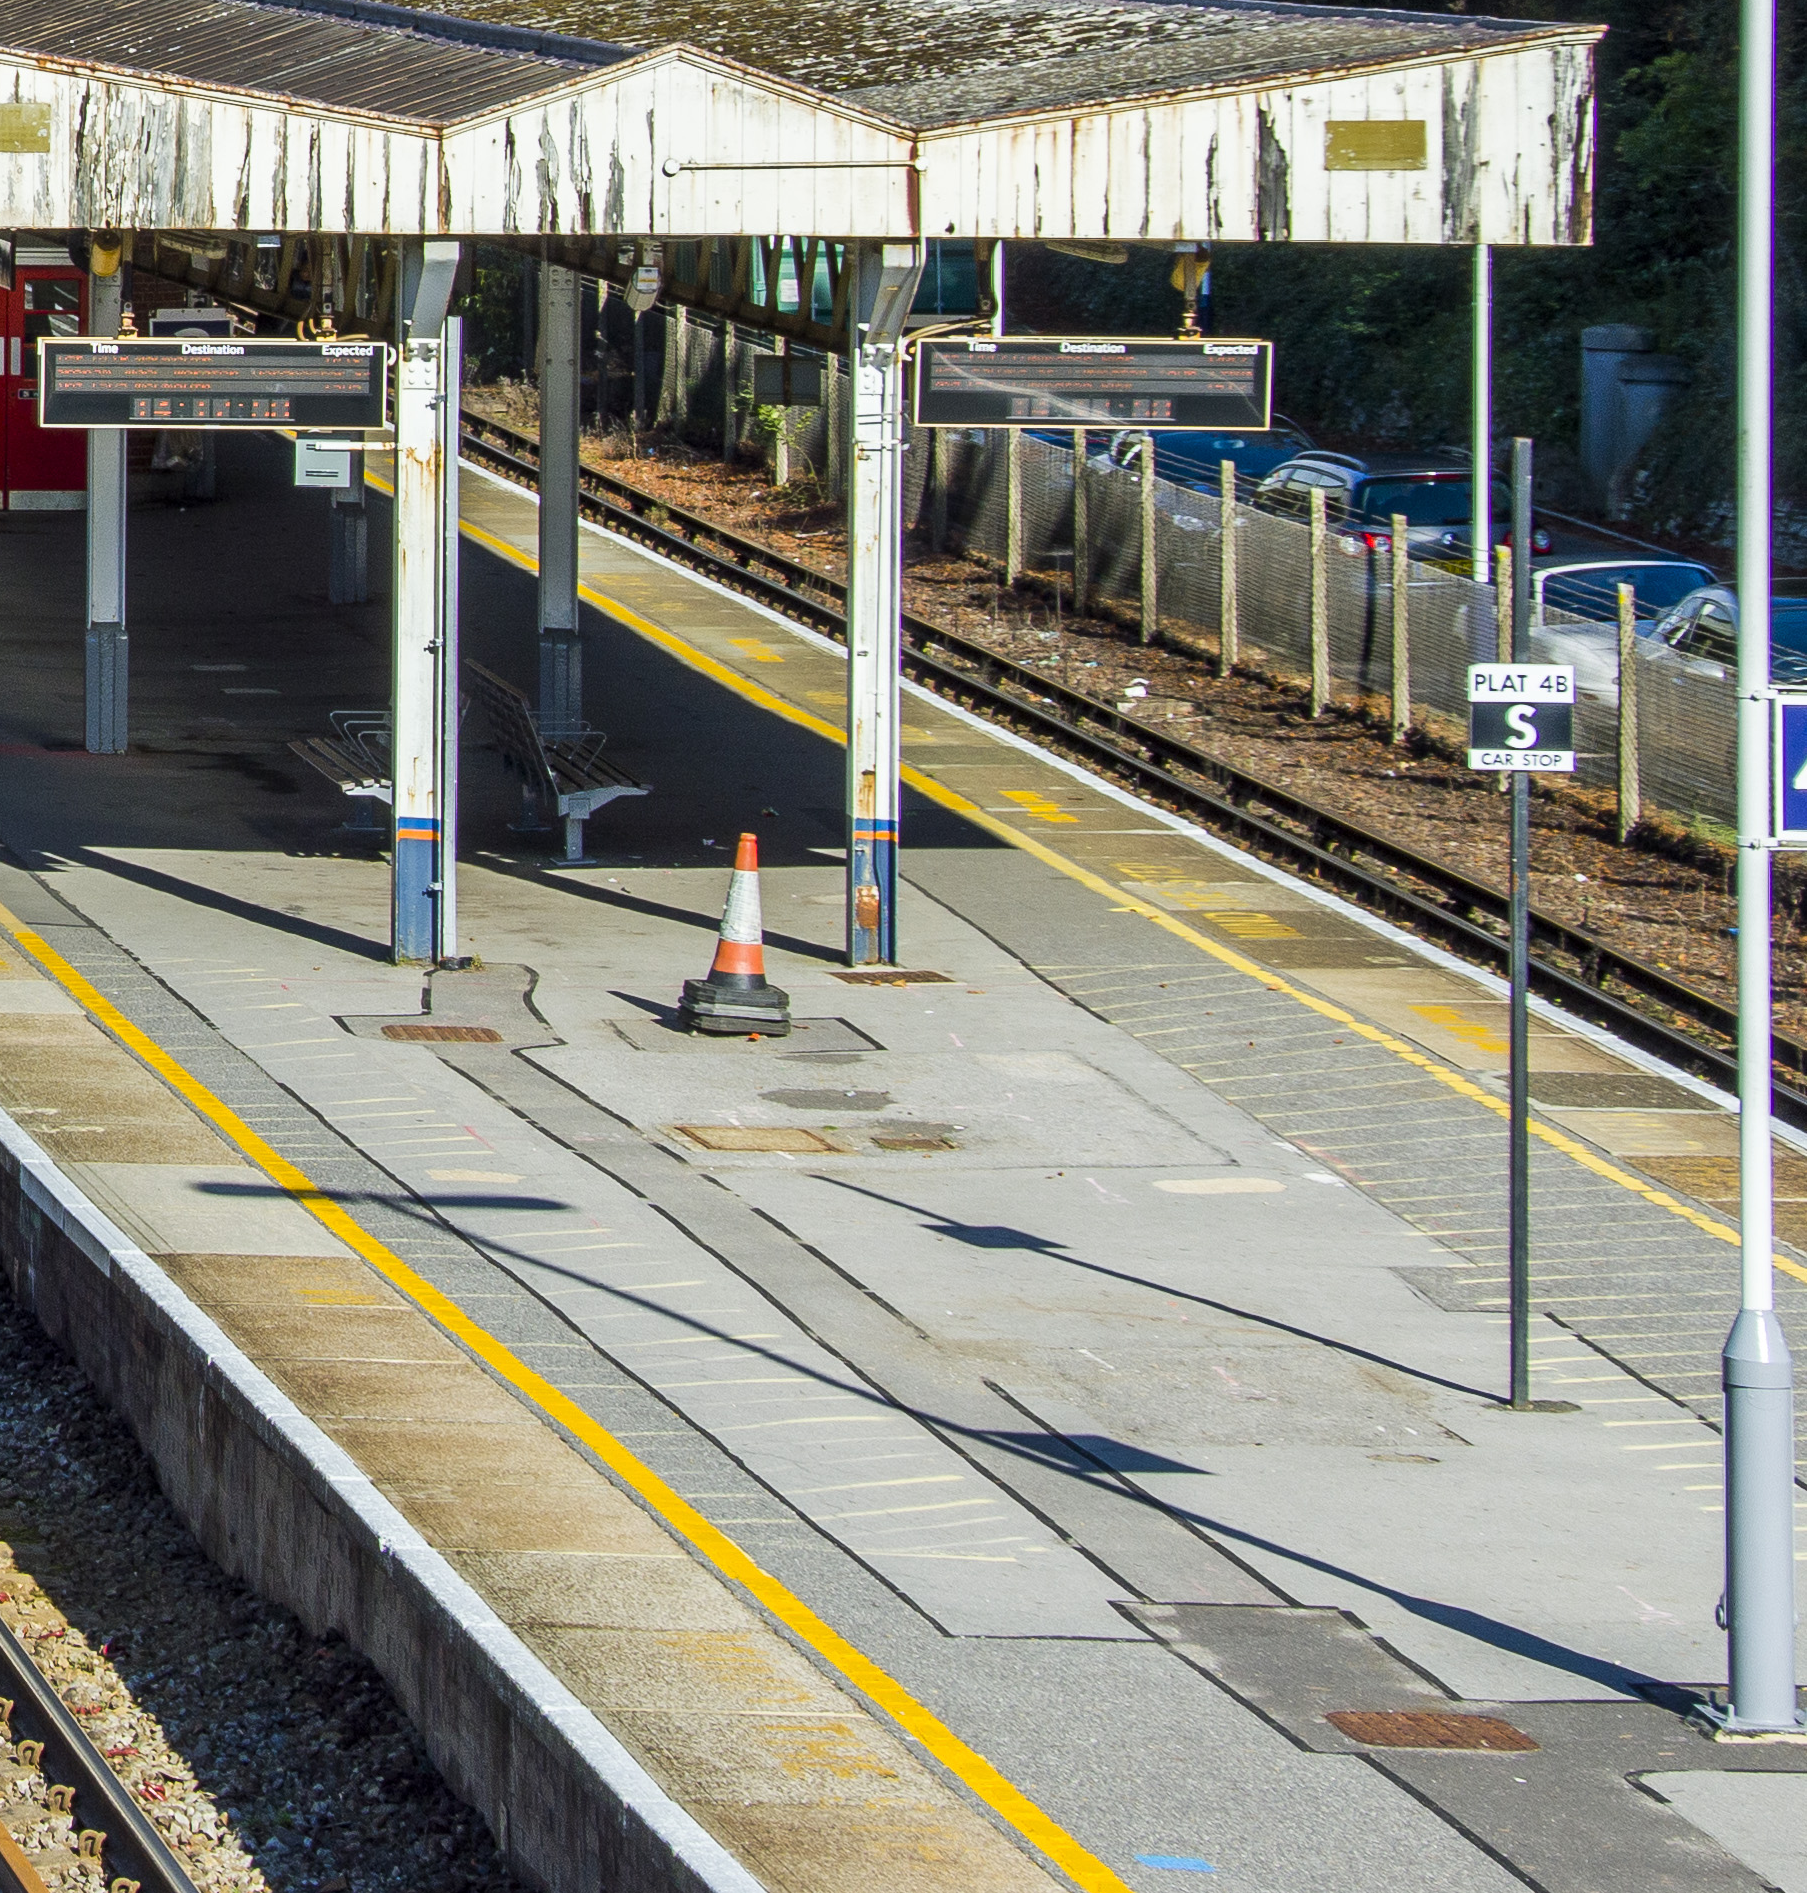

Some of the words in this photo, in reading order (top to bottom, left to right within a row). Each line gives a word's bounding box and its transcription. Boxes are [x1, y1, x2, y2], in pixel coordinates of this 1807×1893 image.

[90, 343, 119, 355] Time
[181, 344, 244, 355] Destination
[322, 345, 374, 357] Expected
[967, 341, 997, 352] Time
[1060, 342, 1126, 354] Destination
[1203, 343, 1259, 356] Expected
[1474, 673, 1528, 692] PLAT
[1539, 675, 1568, 693] 4B
[1504, 703, 1540, 750] S
[1481, 753, 1514, 766] CAR
[1522, 753, 1563, 767] STOP
